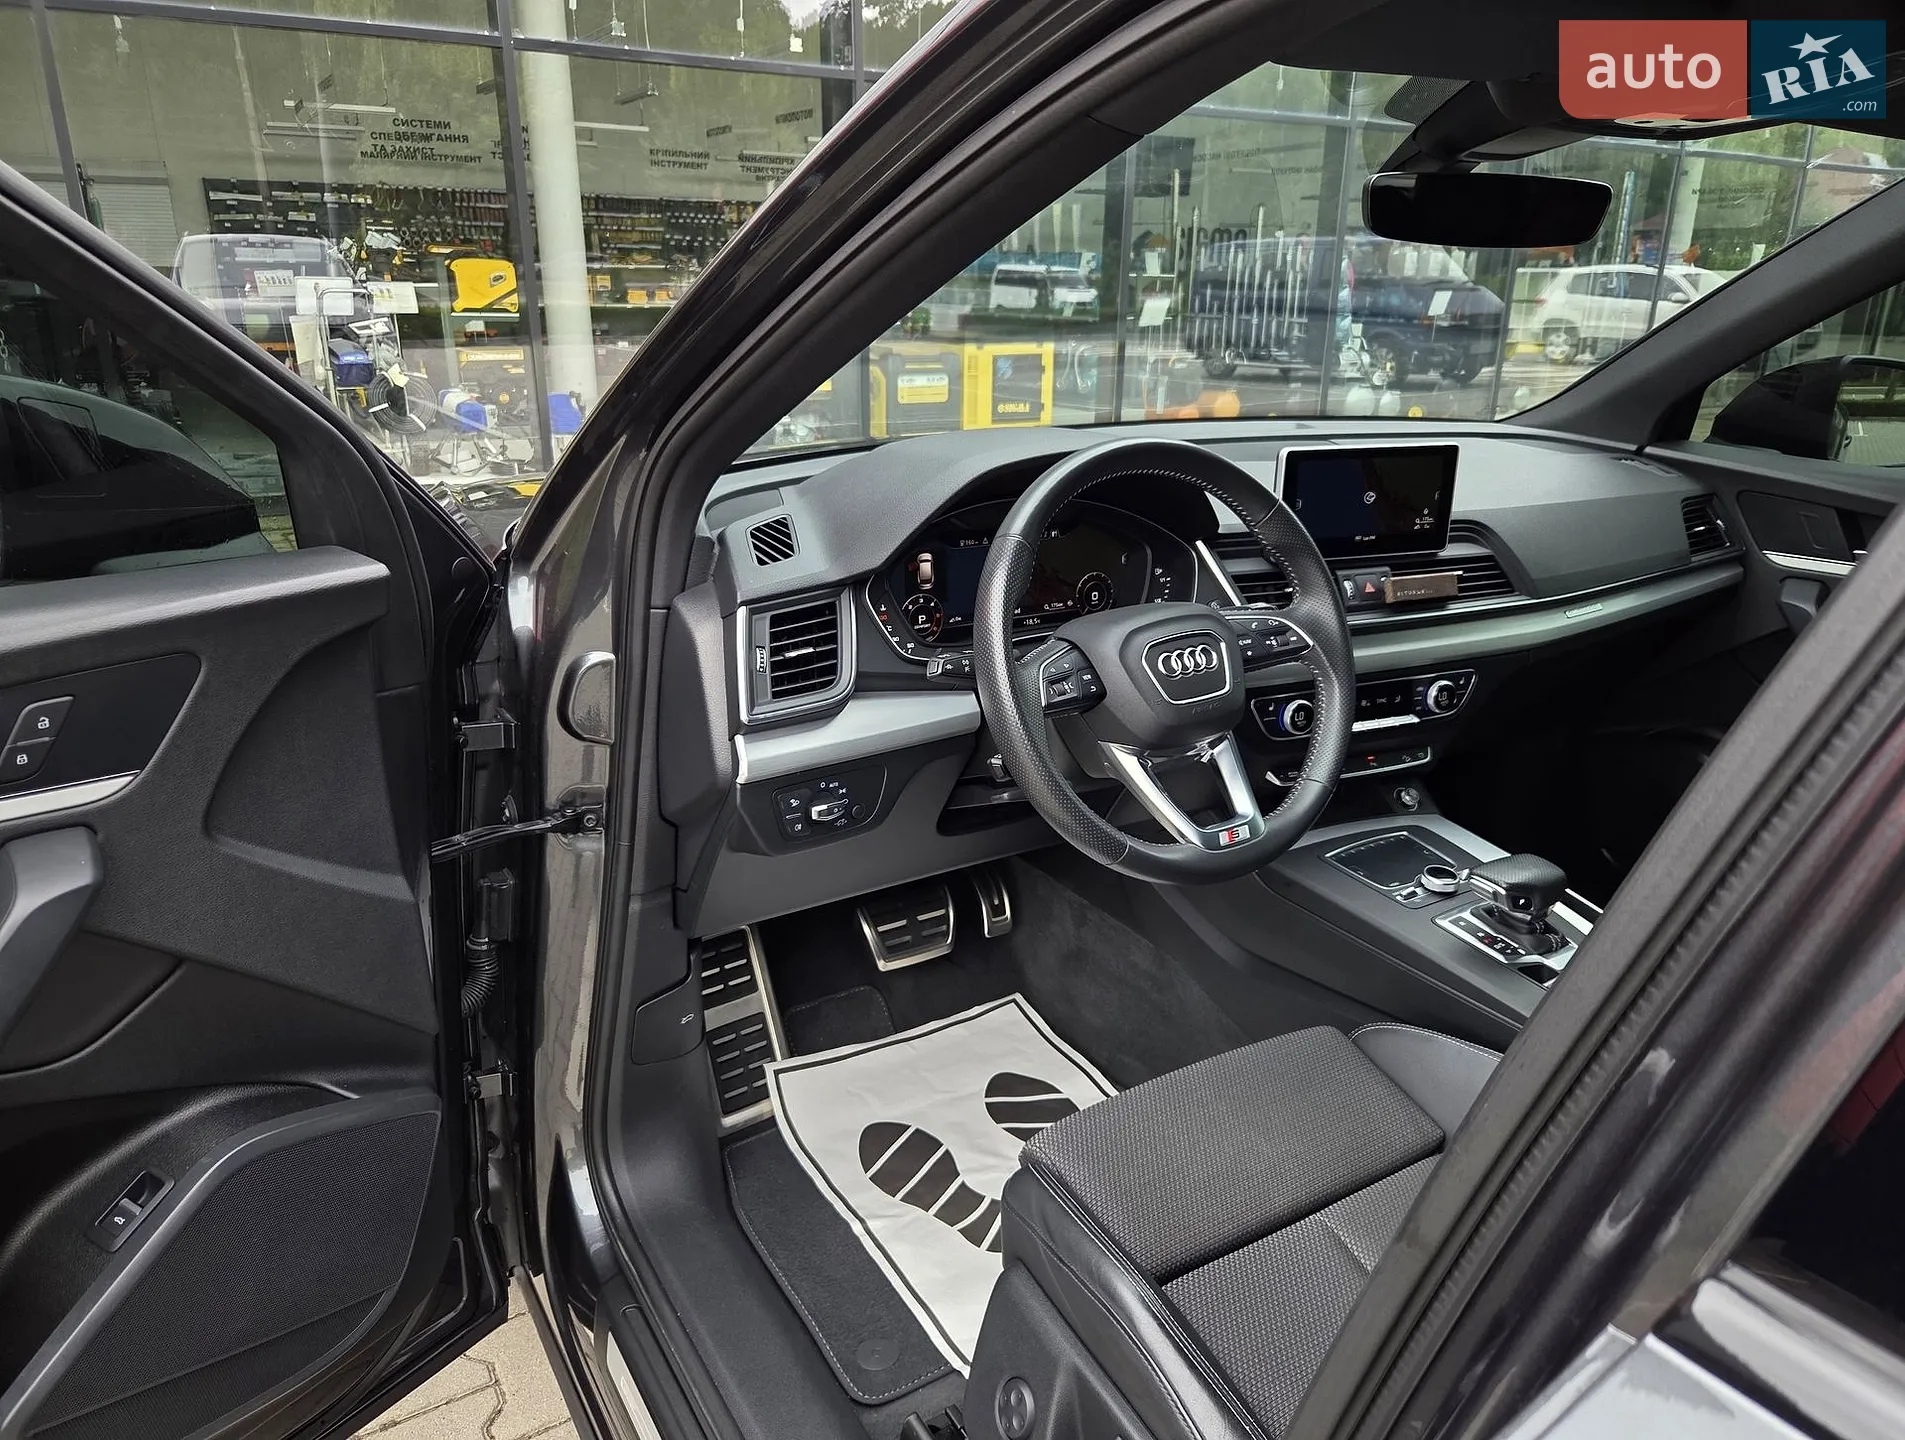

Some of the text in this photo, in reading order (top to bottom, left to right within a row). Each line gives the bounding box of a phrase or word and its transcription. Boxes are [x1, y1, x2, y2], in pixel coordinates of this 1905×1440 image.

[392, 117, 452, 130] СИСТЕМИ
[649, 159, 709, 170] ІНСТРУМЕНТ
[918, 614, 927, 625] P
